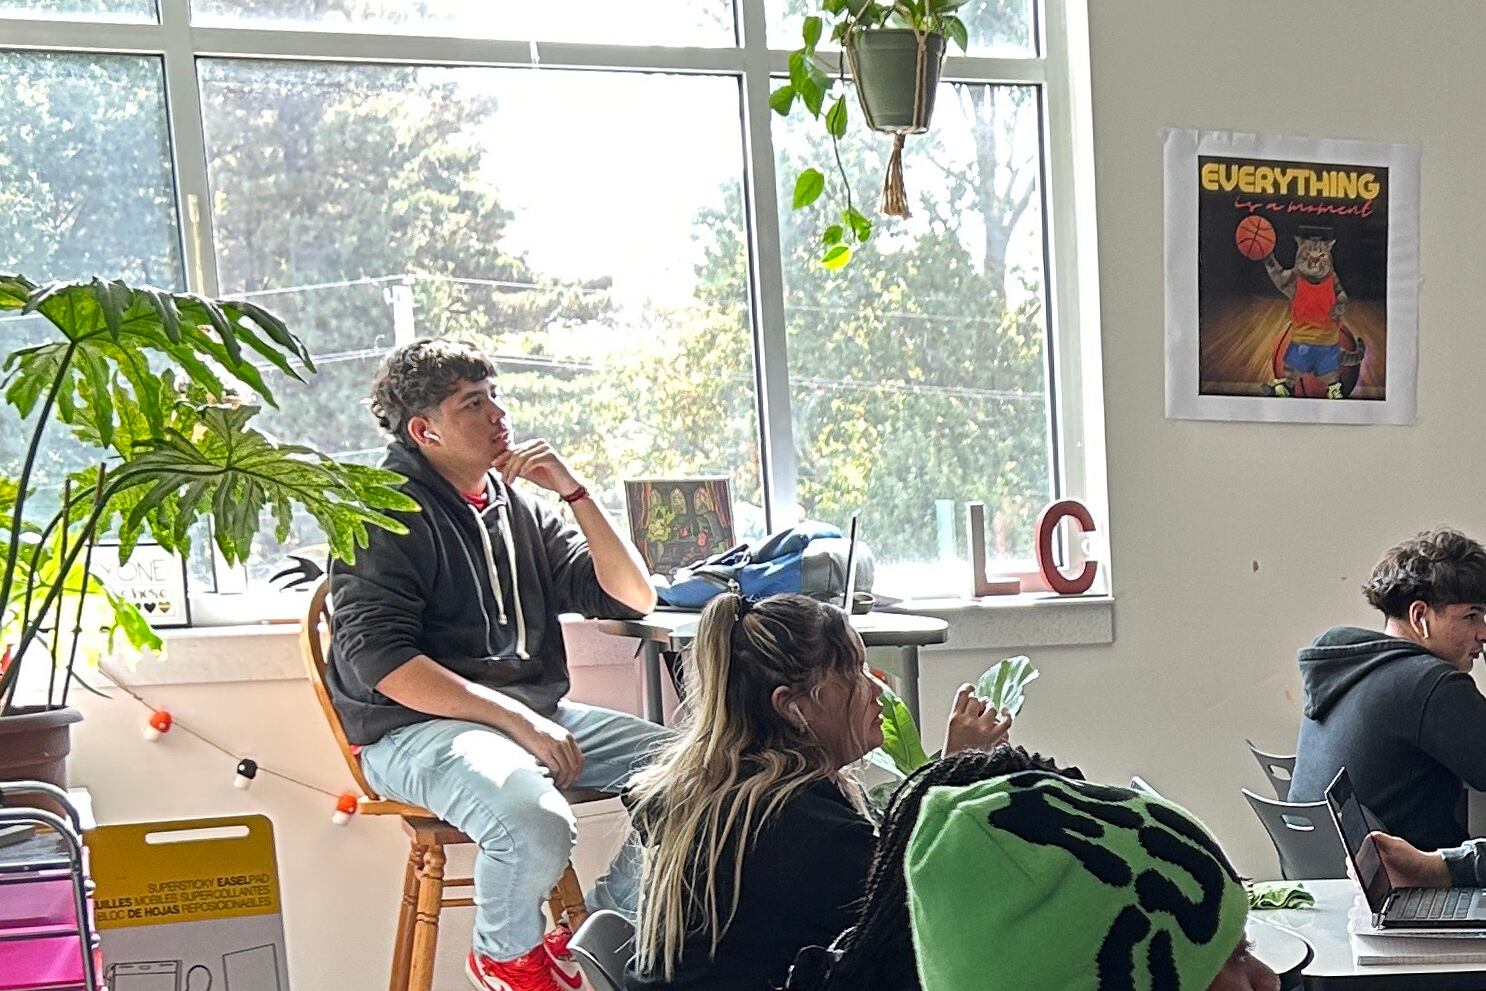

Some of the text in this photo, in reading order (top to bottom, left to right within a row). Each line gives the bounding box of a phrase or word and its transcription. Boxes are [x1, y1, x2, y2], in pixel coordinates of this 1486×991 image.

[1201, 163, 1380, 200] EVERYTHING
[1234, 196, 1373, 217] is a moment
[1037, 500, 1098, 594] C
[147, 874, 270, 894] SUPERSTICKY EASELPAD
[94, 897, 133, 910] UILLES
[134, 893, 178, 907] MOBILES
[98, 897, 271, 922] BLOC DE HOJAS REPOSICIONABLES
